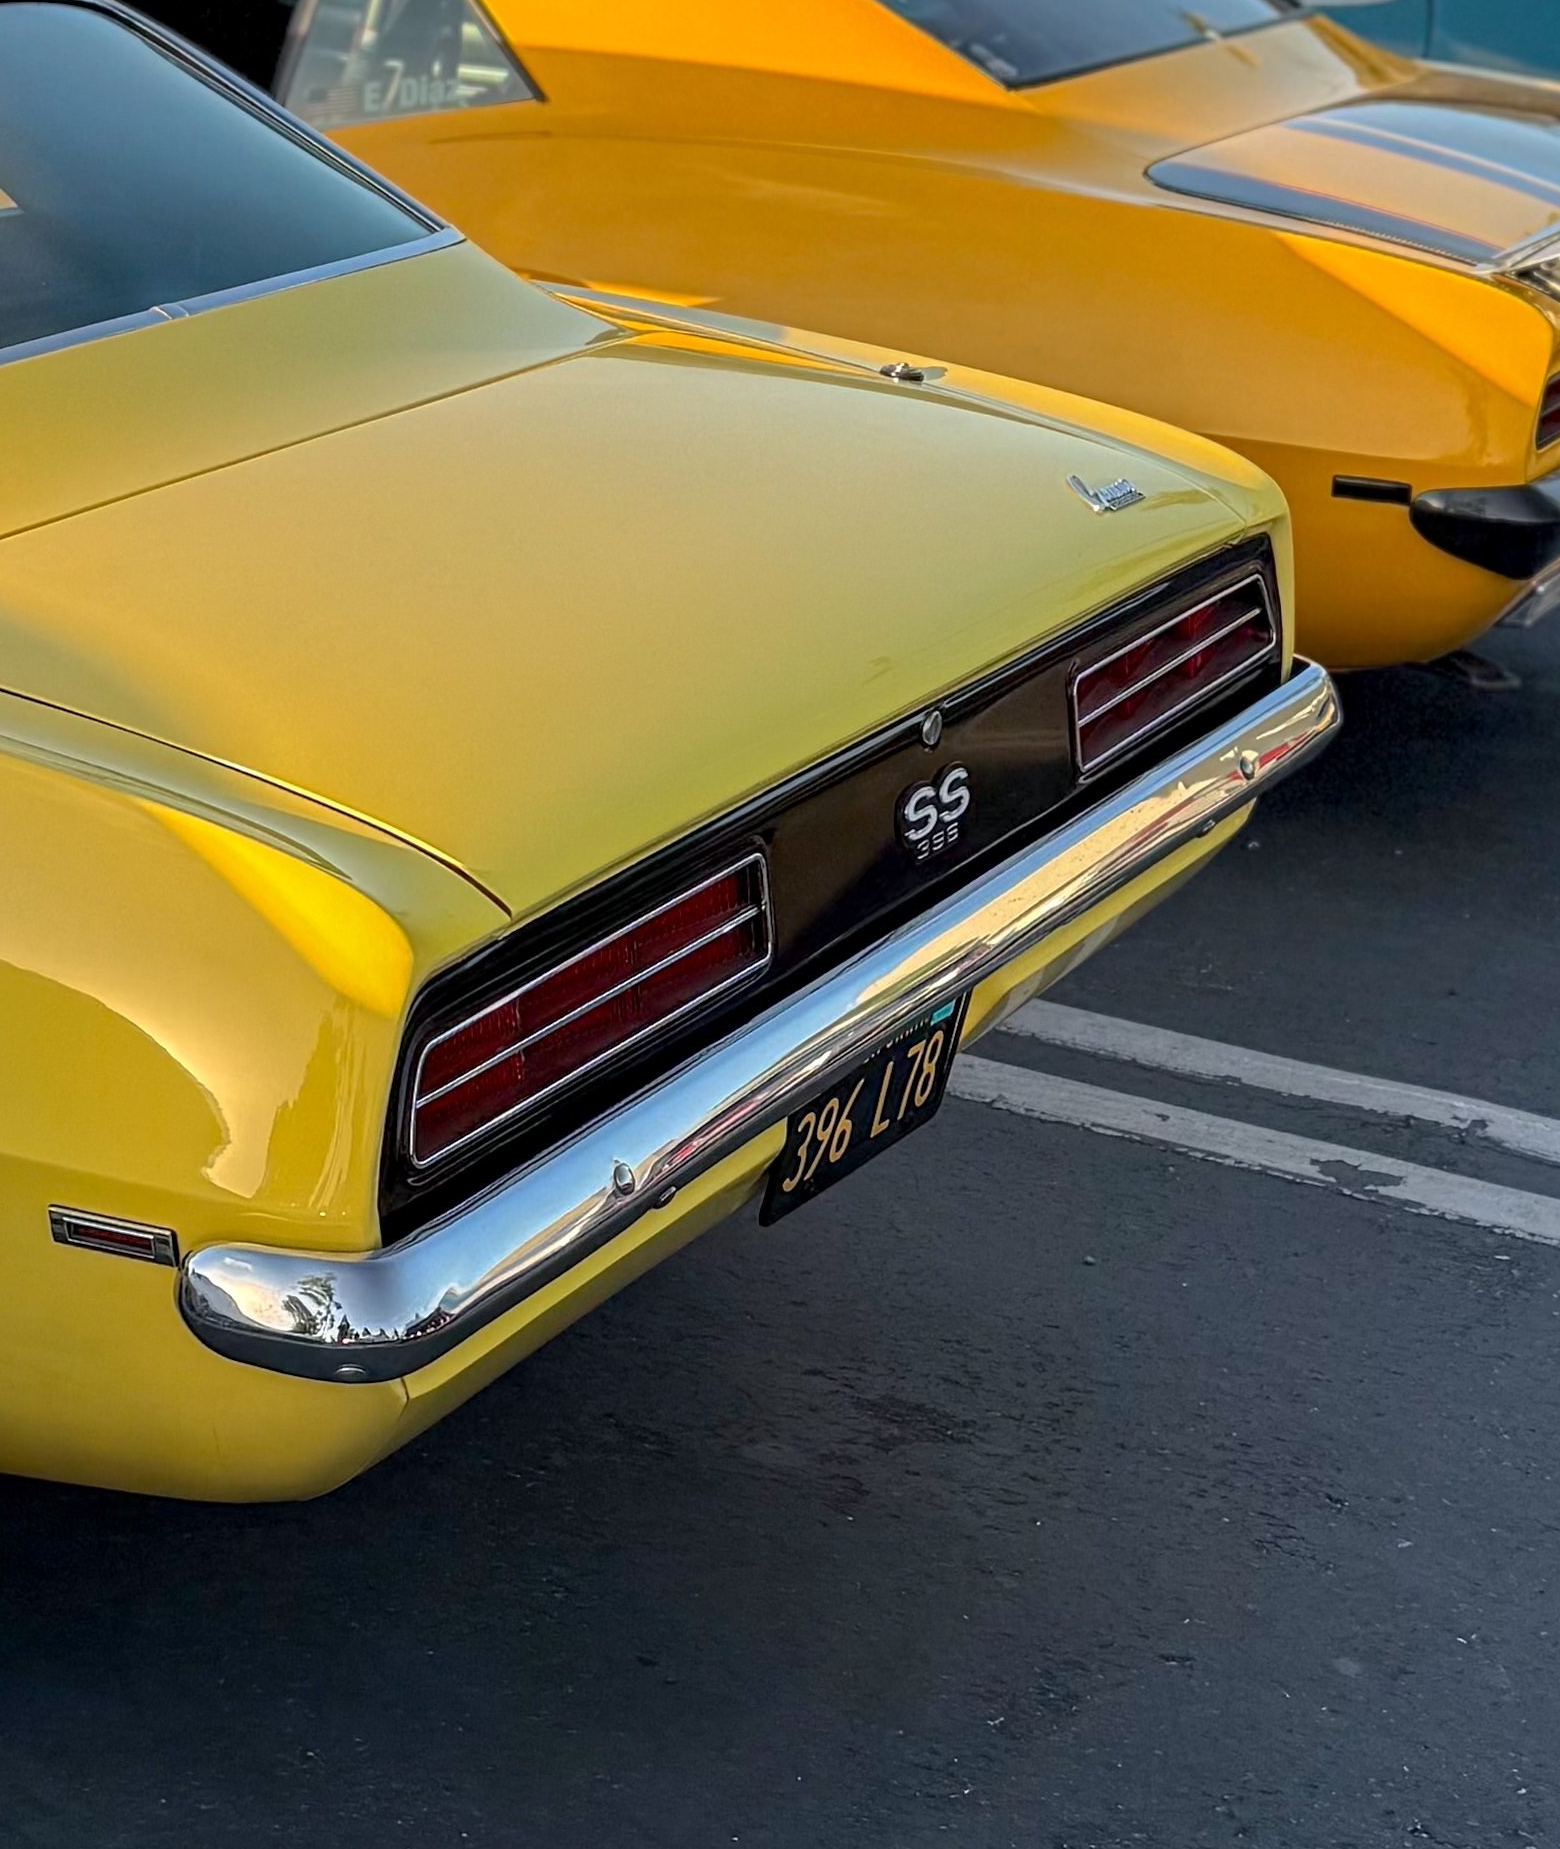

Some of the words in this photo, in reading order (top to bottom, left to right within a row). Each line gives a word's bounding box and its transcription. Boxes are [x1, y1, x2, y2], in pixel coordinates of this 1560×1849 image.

[904, 767, 970, 841] SS
[782, 1077, 865, 1193] 396
[870, 1030, 944, 1139] L78
